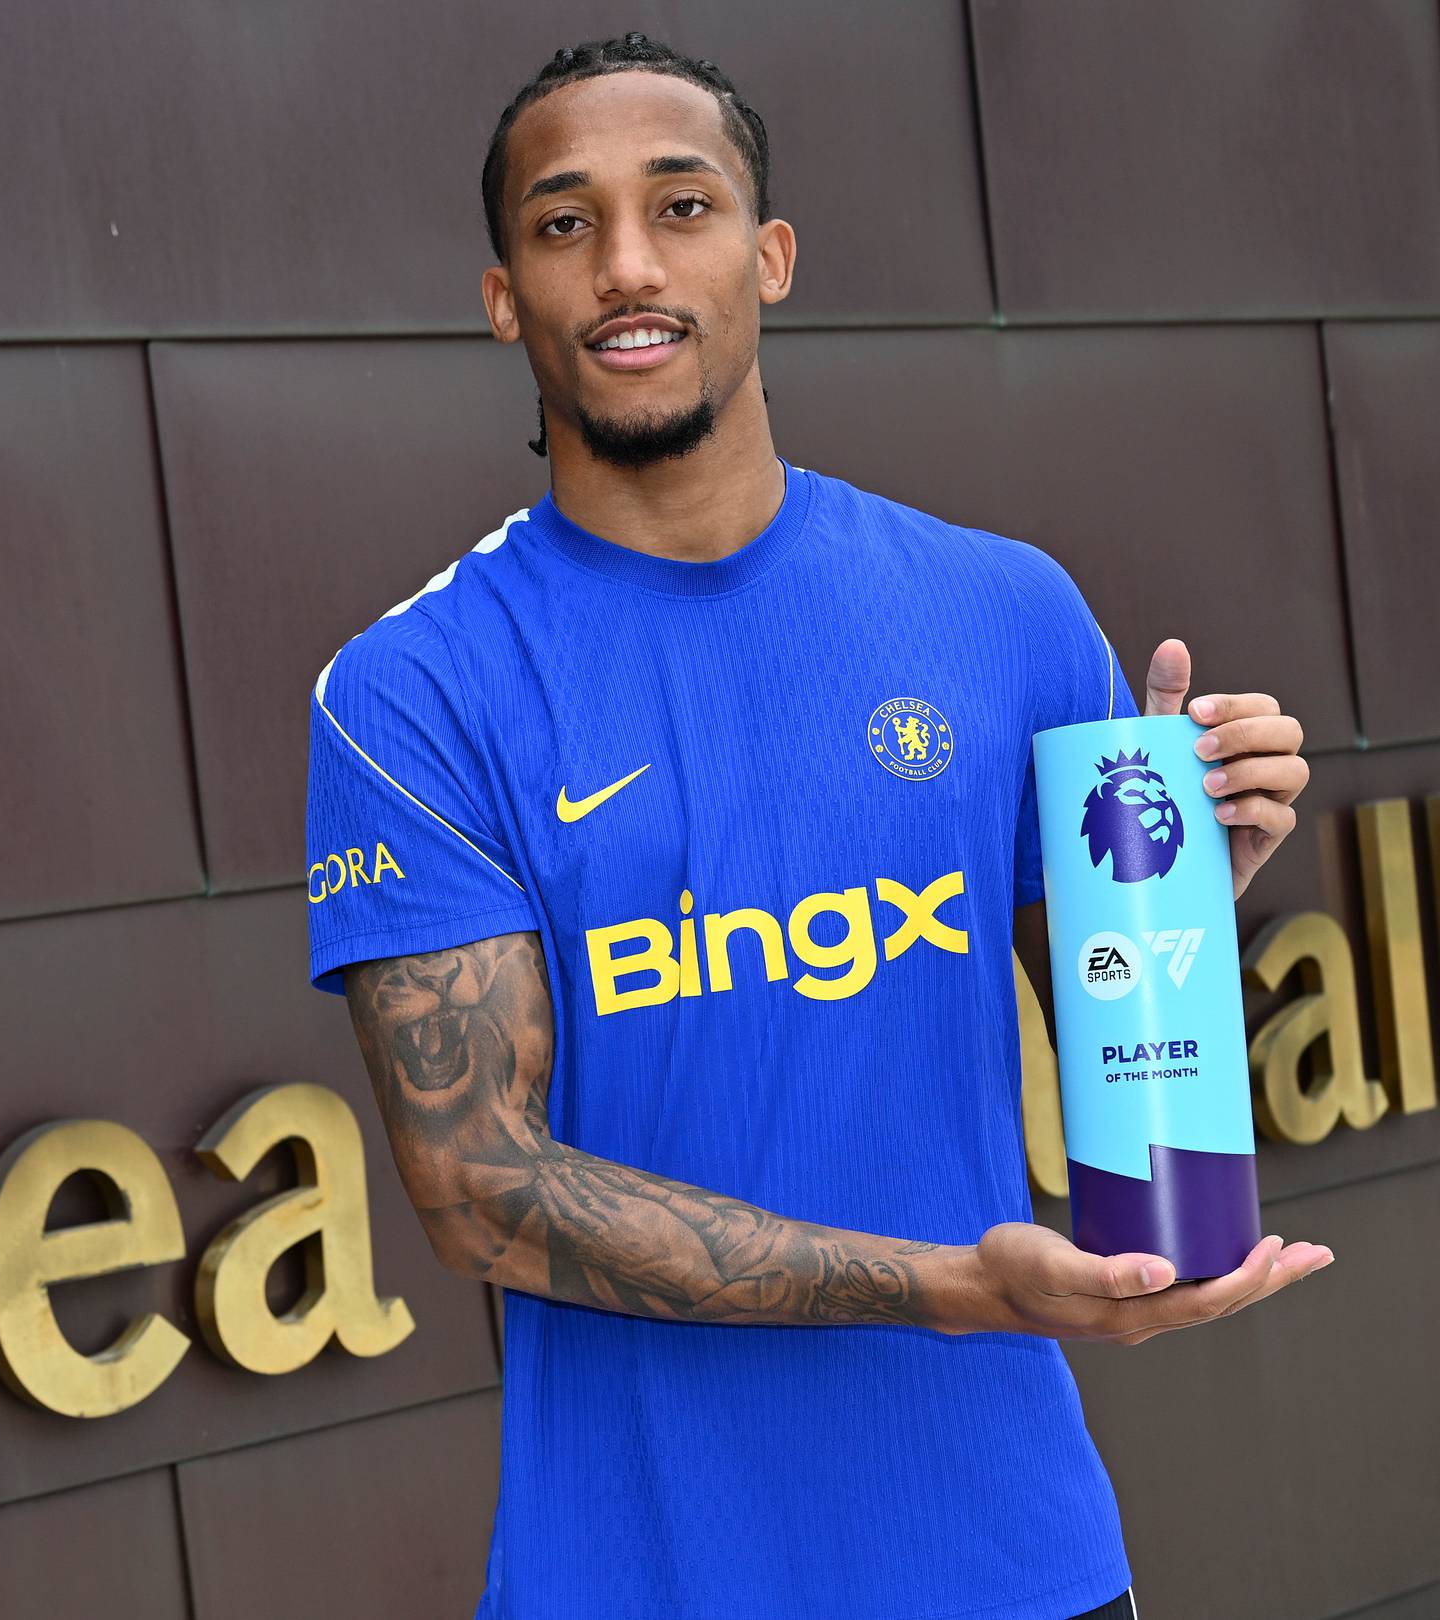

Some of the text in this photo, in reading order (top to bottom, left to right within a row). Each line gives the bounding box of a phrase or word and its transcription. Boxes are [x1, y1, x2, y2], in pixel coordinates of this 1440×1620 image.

[879, 700, 931, 718] CHELSEA
[889, 759, 943, 776] FOOTBALL CLUB
[1087, 946, 1129, 972] EA
[1087, 968, 1131, 983] SPORTS
[1102, 1039, 1199, 1064] PLAYER
[1105, 1067, 1198, 1083] OF THE MONTH
